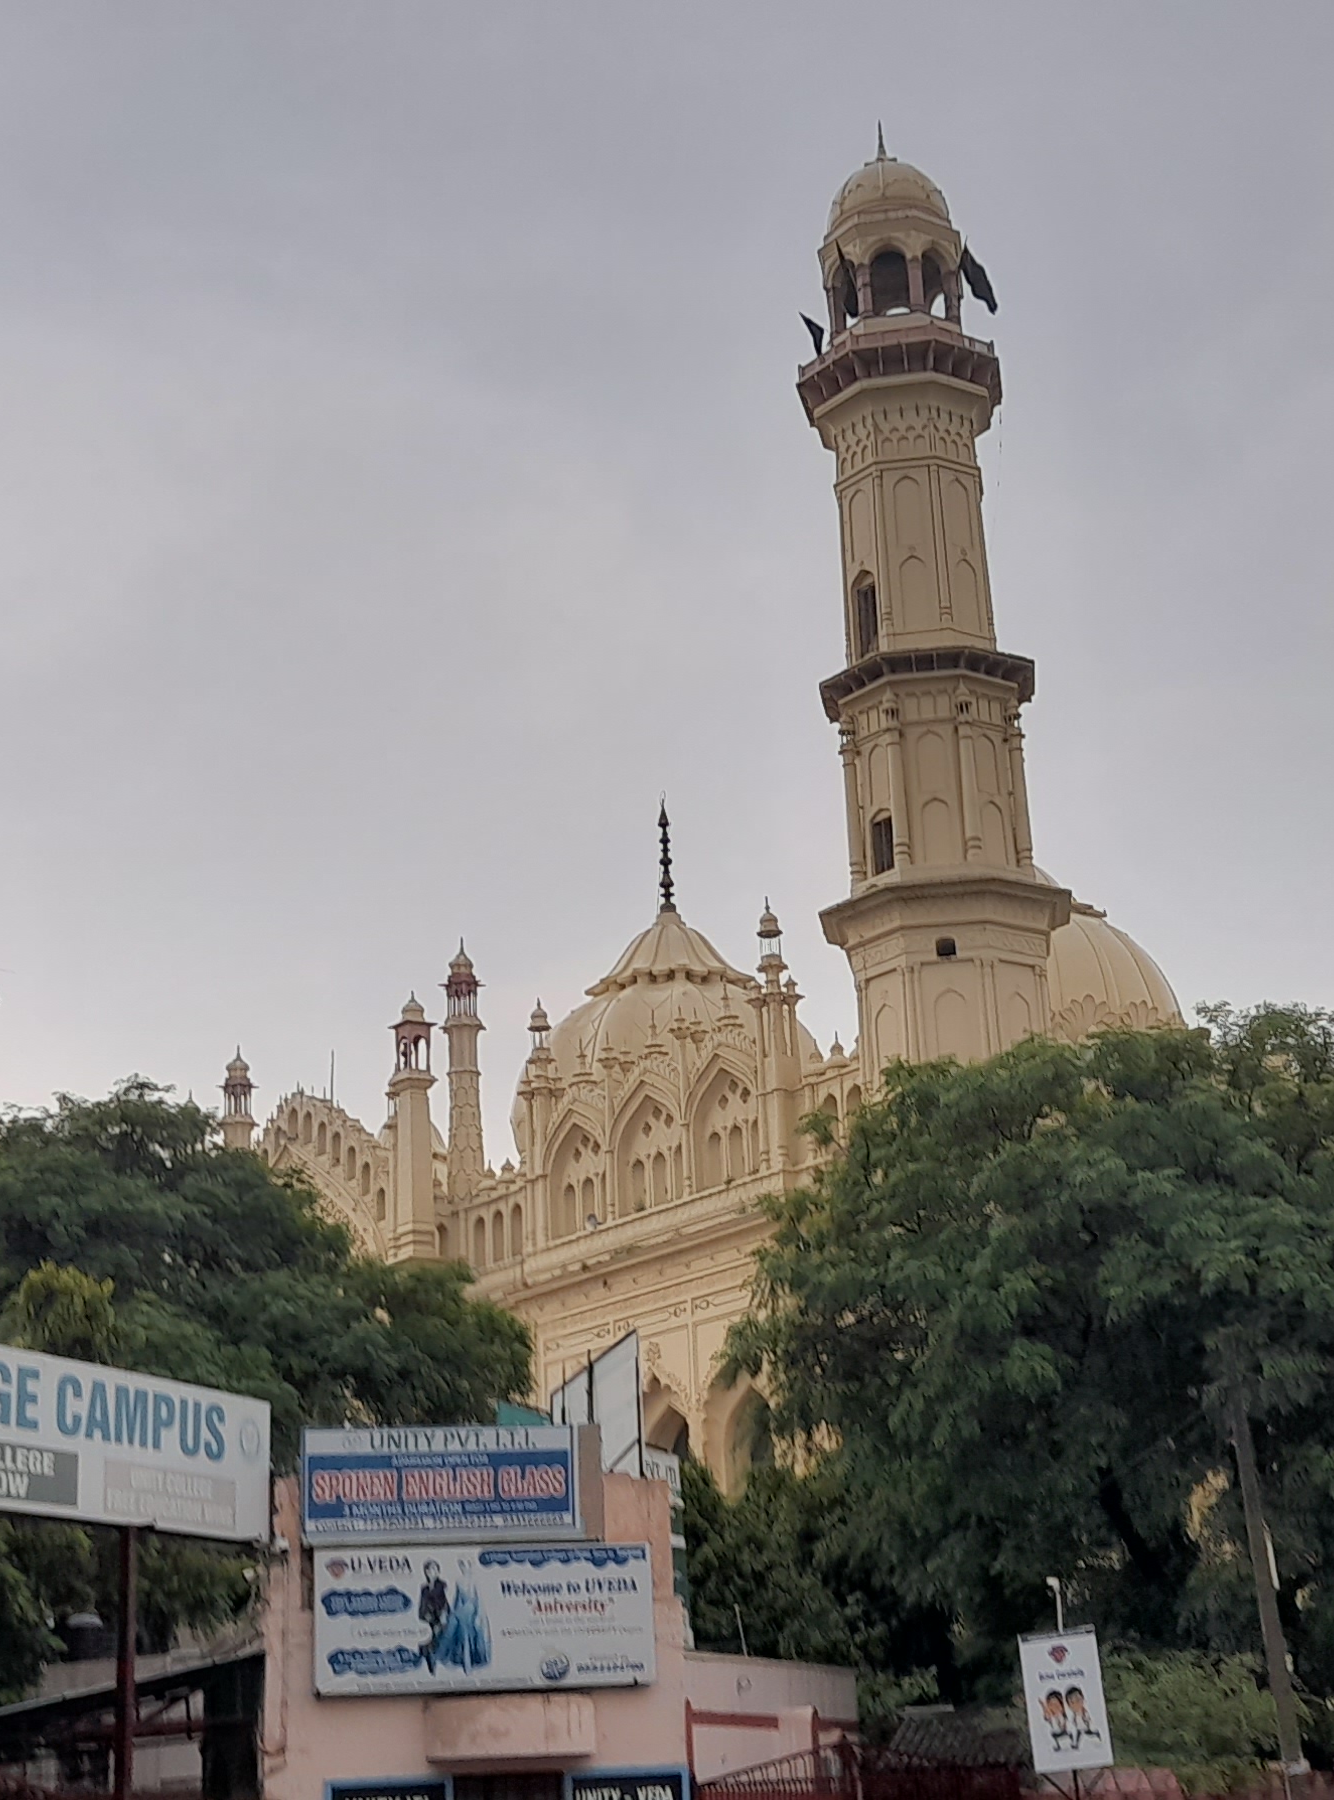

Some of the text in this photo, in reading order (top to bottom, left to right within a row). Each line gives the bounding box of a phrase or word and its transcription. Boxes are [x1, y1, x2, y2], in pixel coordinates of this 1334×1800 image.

[56, 1373, 226, 1462] CAMPUS
[369, 1429, 435, 1451] UNITY
[312, 1464, 566, 1504] SPOKEN ENGLISH CLASS
[500, 1579, 563, 1597] Welcome
[566, 1580, 581, 1595] to
